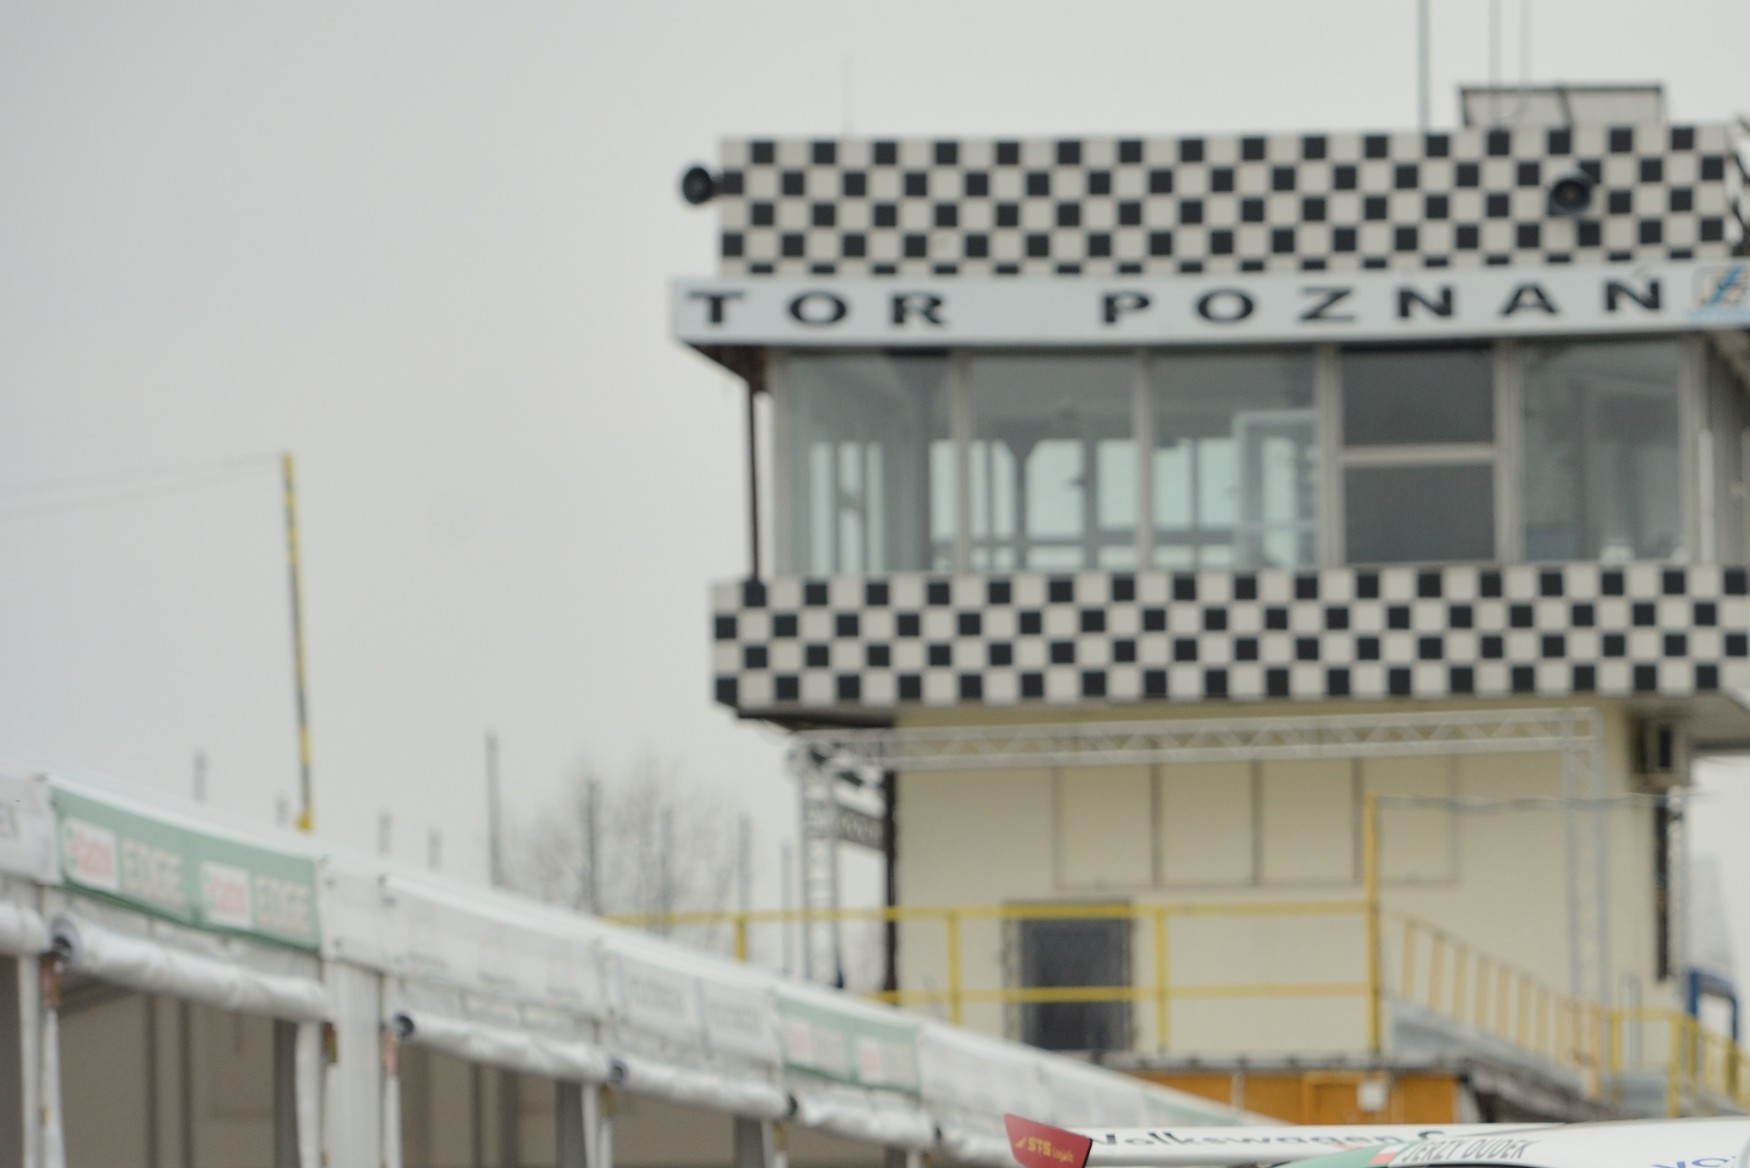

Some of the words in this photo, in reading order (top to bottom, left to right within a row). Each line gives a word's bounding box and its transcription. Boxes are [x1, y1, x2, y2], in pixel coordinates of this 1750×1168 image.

[689, 290, 947, 327] TOR
[1100, 266, 1663, 325] POZNAŃ
[1402, 1139, 1461, 1162] JERZY
[1460, 1141, 1540, 1160] DUDEK
